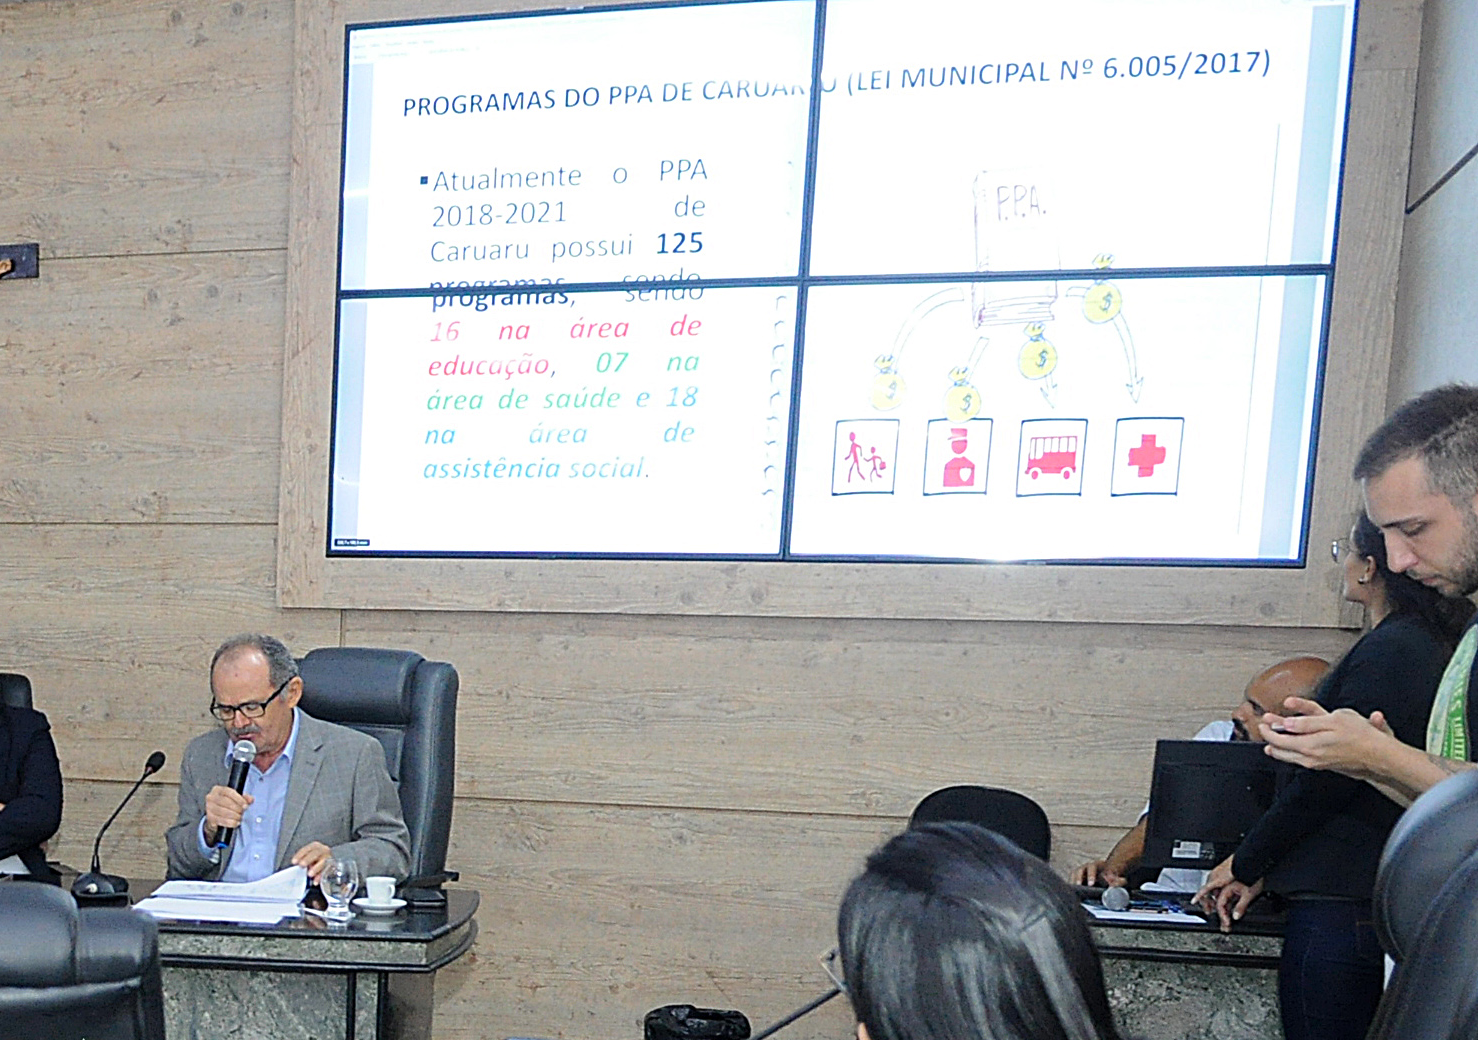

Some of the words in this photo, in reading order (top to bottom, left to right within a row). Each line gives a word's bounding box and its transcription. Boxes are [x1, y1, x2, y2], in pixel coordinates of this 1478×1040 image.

[403, 89, 556, 116] PROGRAMAS
[564, 87, 600, 108] DO
[609, 84, 653, 105] PPA
[663, 82, 693, 102] DE
[847, 69, 891, 97] (LEI
[901, 60, 1050, 89] MUNICIPAL
[1060, 59, 1094, 81] Nº
[1103, 49, 1271, 80] 6.005/2017)
[433, 166, 582, 192] Atualmente
[612, 166, 628, 184] o
[659, 158, 708, 182] PPA
[432, 201, 567, 228] 2018-2021
[674, 194, 707, 218] de
[430, 240, 530, 263] Caruaru
[551, 233, 633, 263] possui
[656, 231, 704, 255] 125
[429, 320, 462, 342] 16
[498, 323, 531, 341] na
[569, 316, 630, 339] área
[670, 313, 702, 337] de
[427, 352, 557, 381] educação,
[595, 352, 629, 374] 07
[666, 354, 700, 373] na
[426, 388, 484, 411] área
[497, 387, 529, 410] de
[542, 385, 621, 410] saúde
[635, 391, 650, 408] e
[665, 385, 699, 408] 18
[424, 428, 456, 445] na
[528, 421, 588, 445] área
[663, 420, 695, 443] de
[422, 456, 560, 479] assistência
[568, 456, 650, 479] social.
